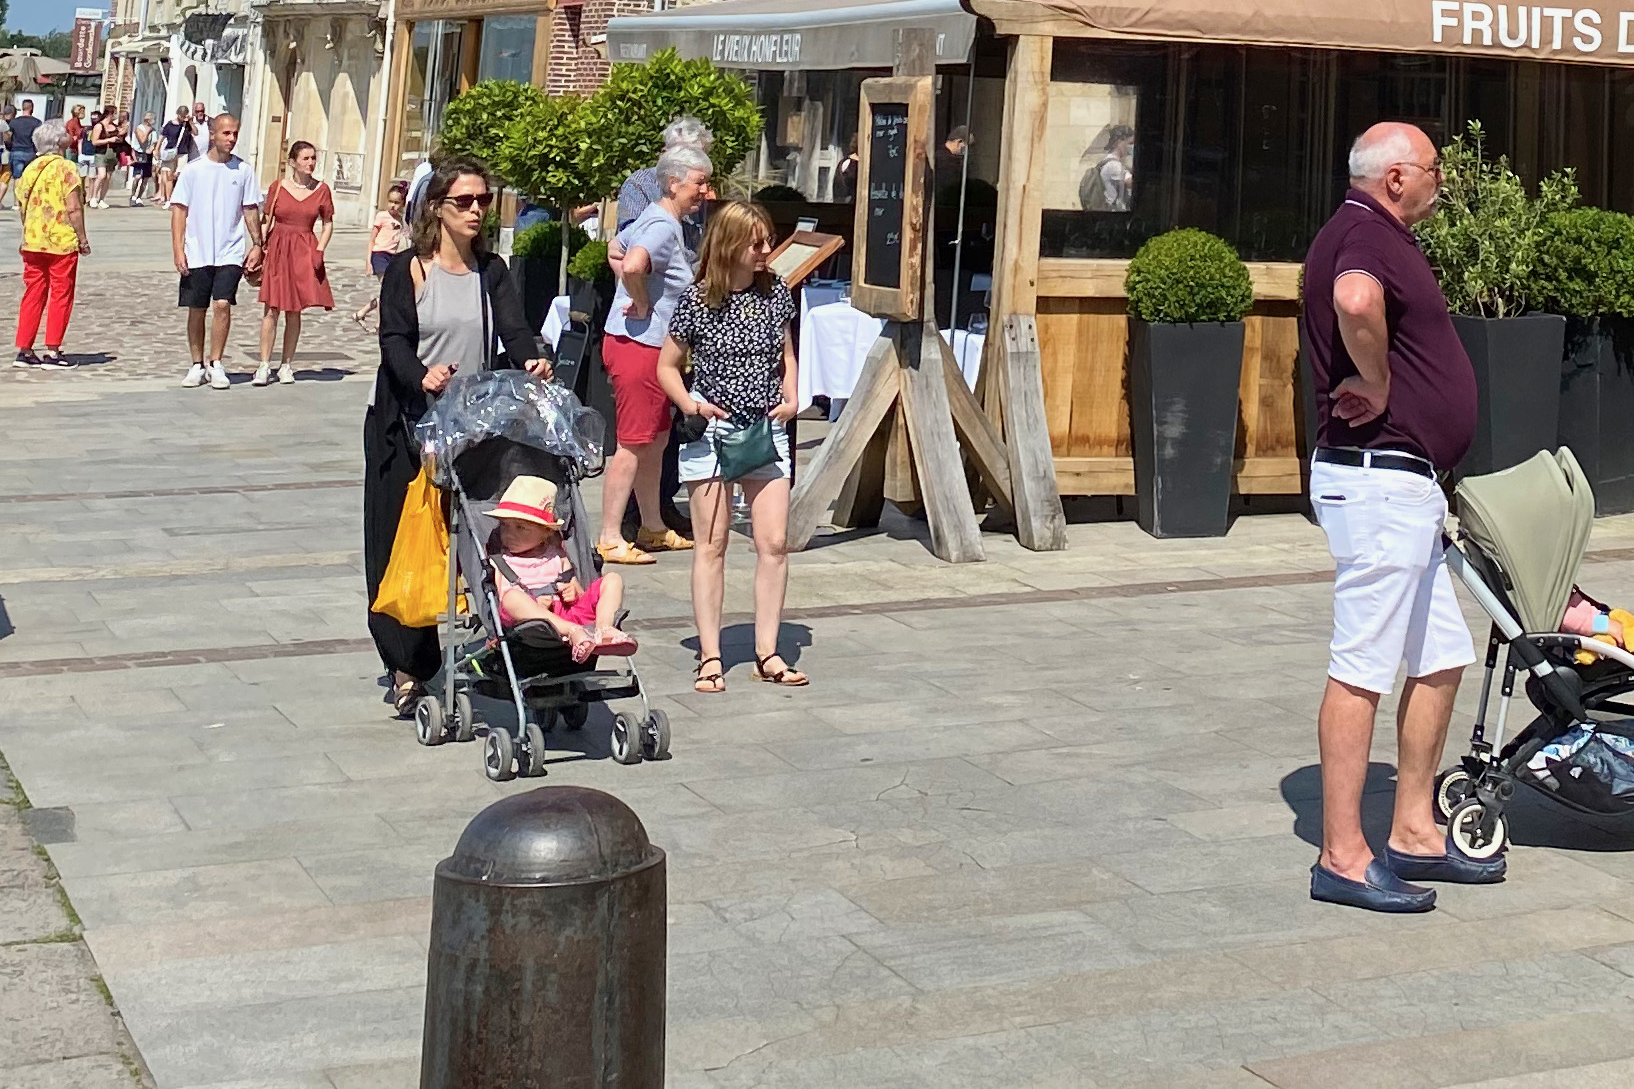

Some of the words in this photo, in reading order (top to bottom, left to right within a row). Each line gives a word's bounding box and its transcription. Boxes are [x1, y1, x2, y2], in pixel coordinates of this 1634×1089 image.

[712, 34, 724, 61] LE
[751, 32, 801, 63] HONFLEUR
[1431, 0, 1603, 53] FRUITS
